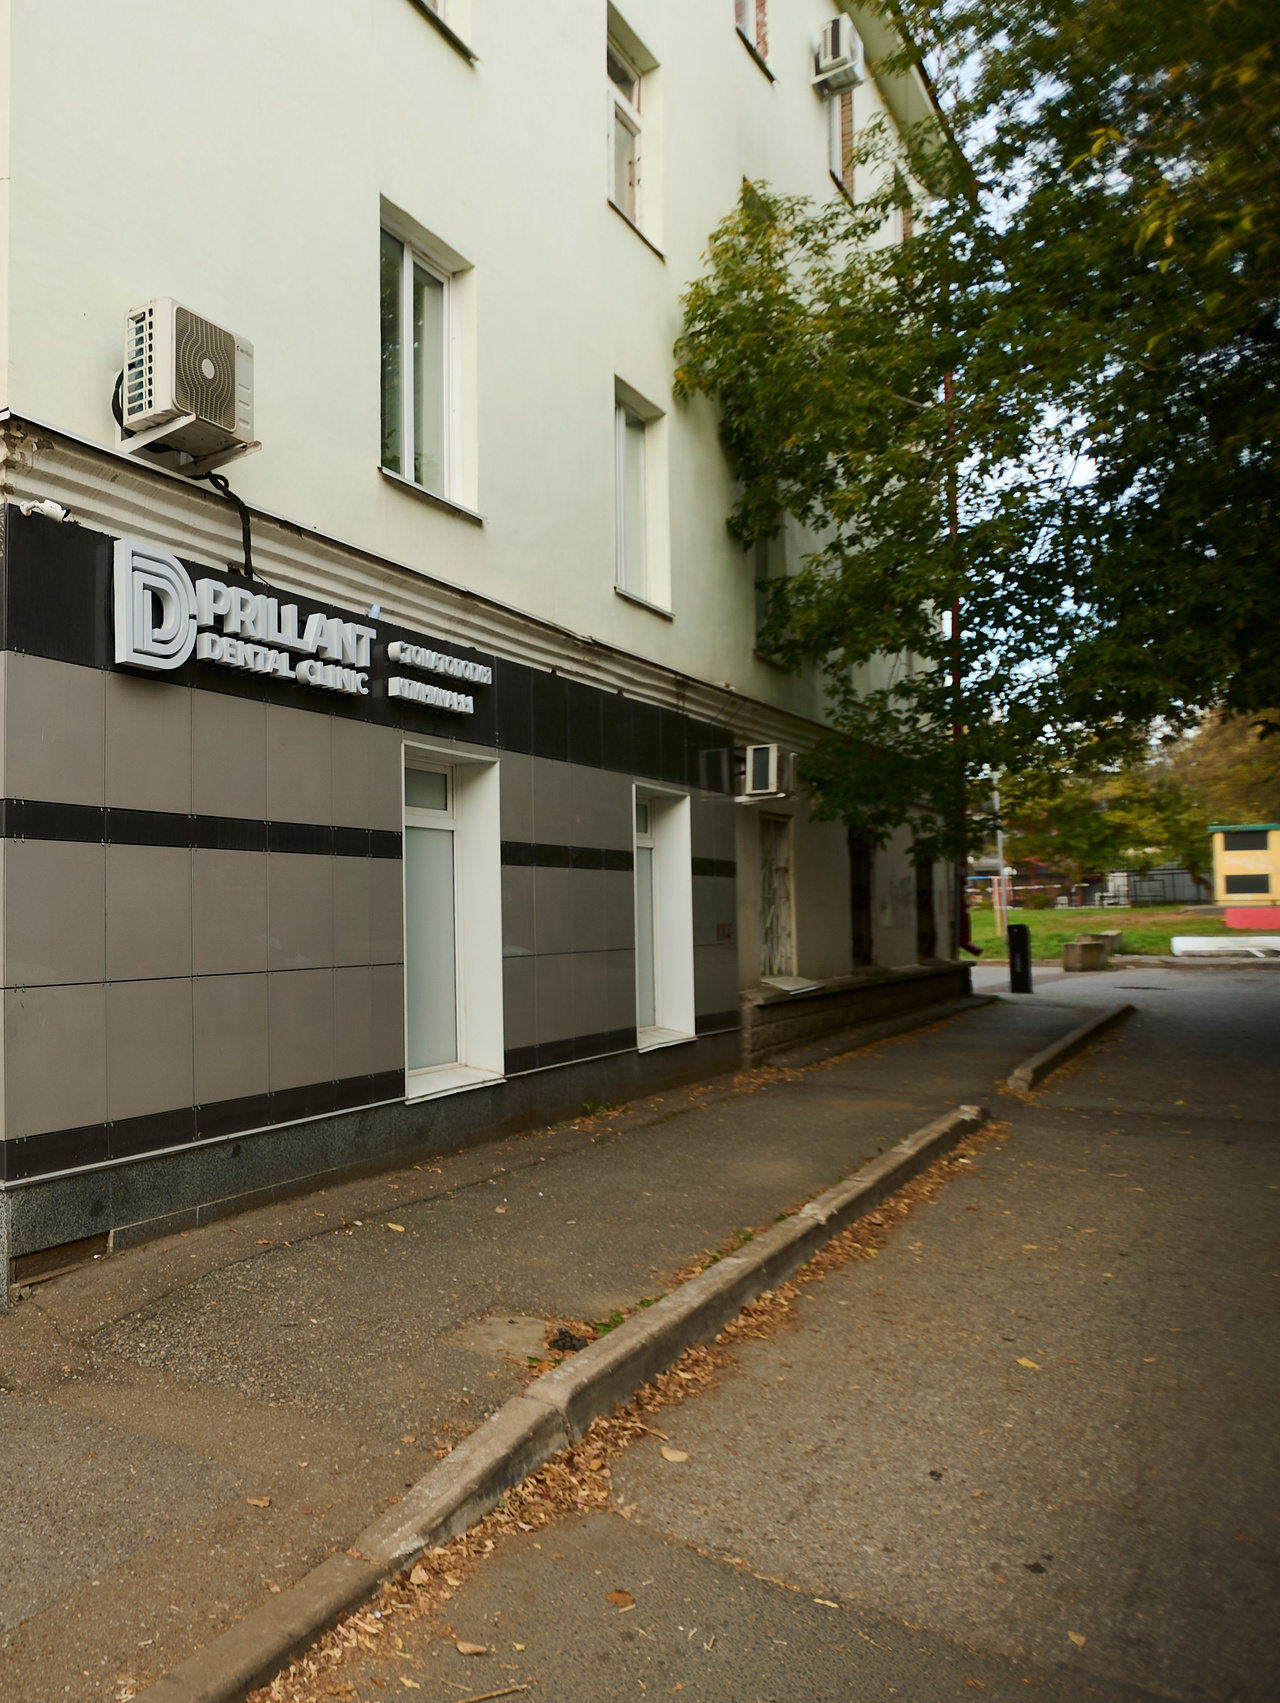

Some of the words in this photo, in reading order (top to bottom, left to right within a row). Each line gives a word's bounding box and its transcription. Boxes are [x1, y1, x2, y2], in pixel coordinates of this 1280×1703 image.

[196, 578, 376, 668] PRILLANT
[196, 632, 296, 679] DENTAL
[295, 659, 370, 696] CLINIC
